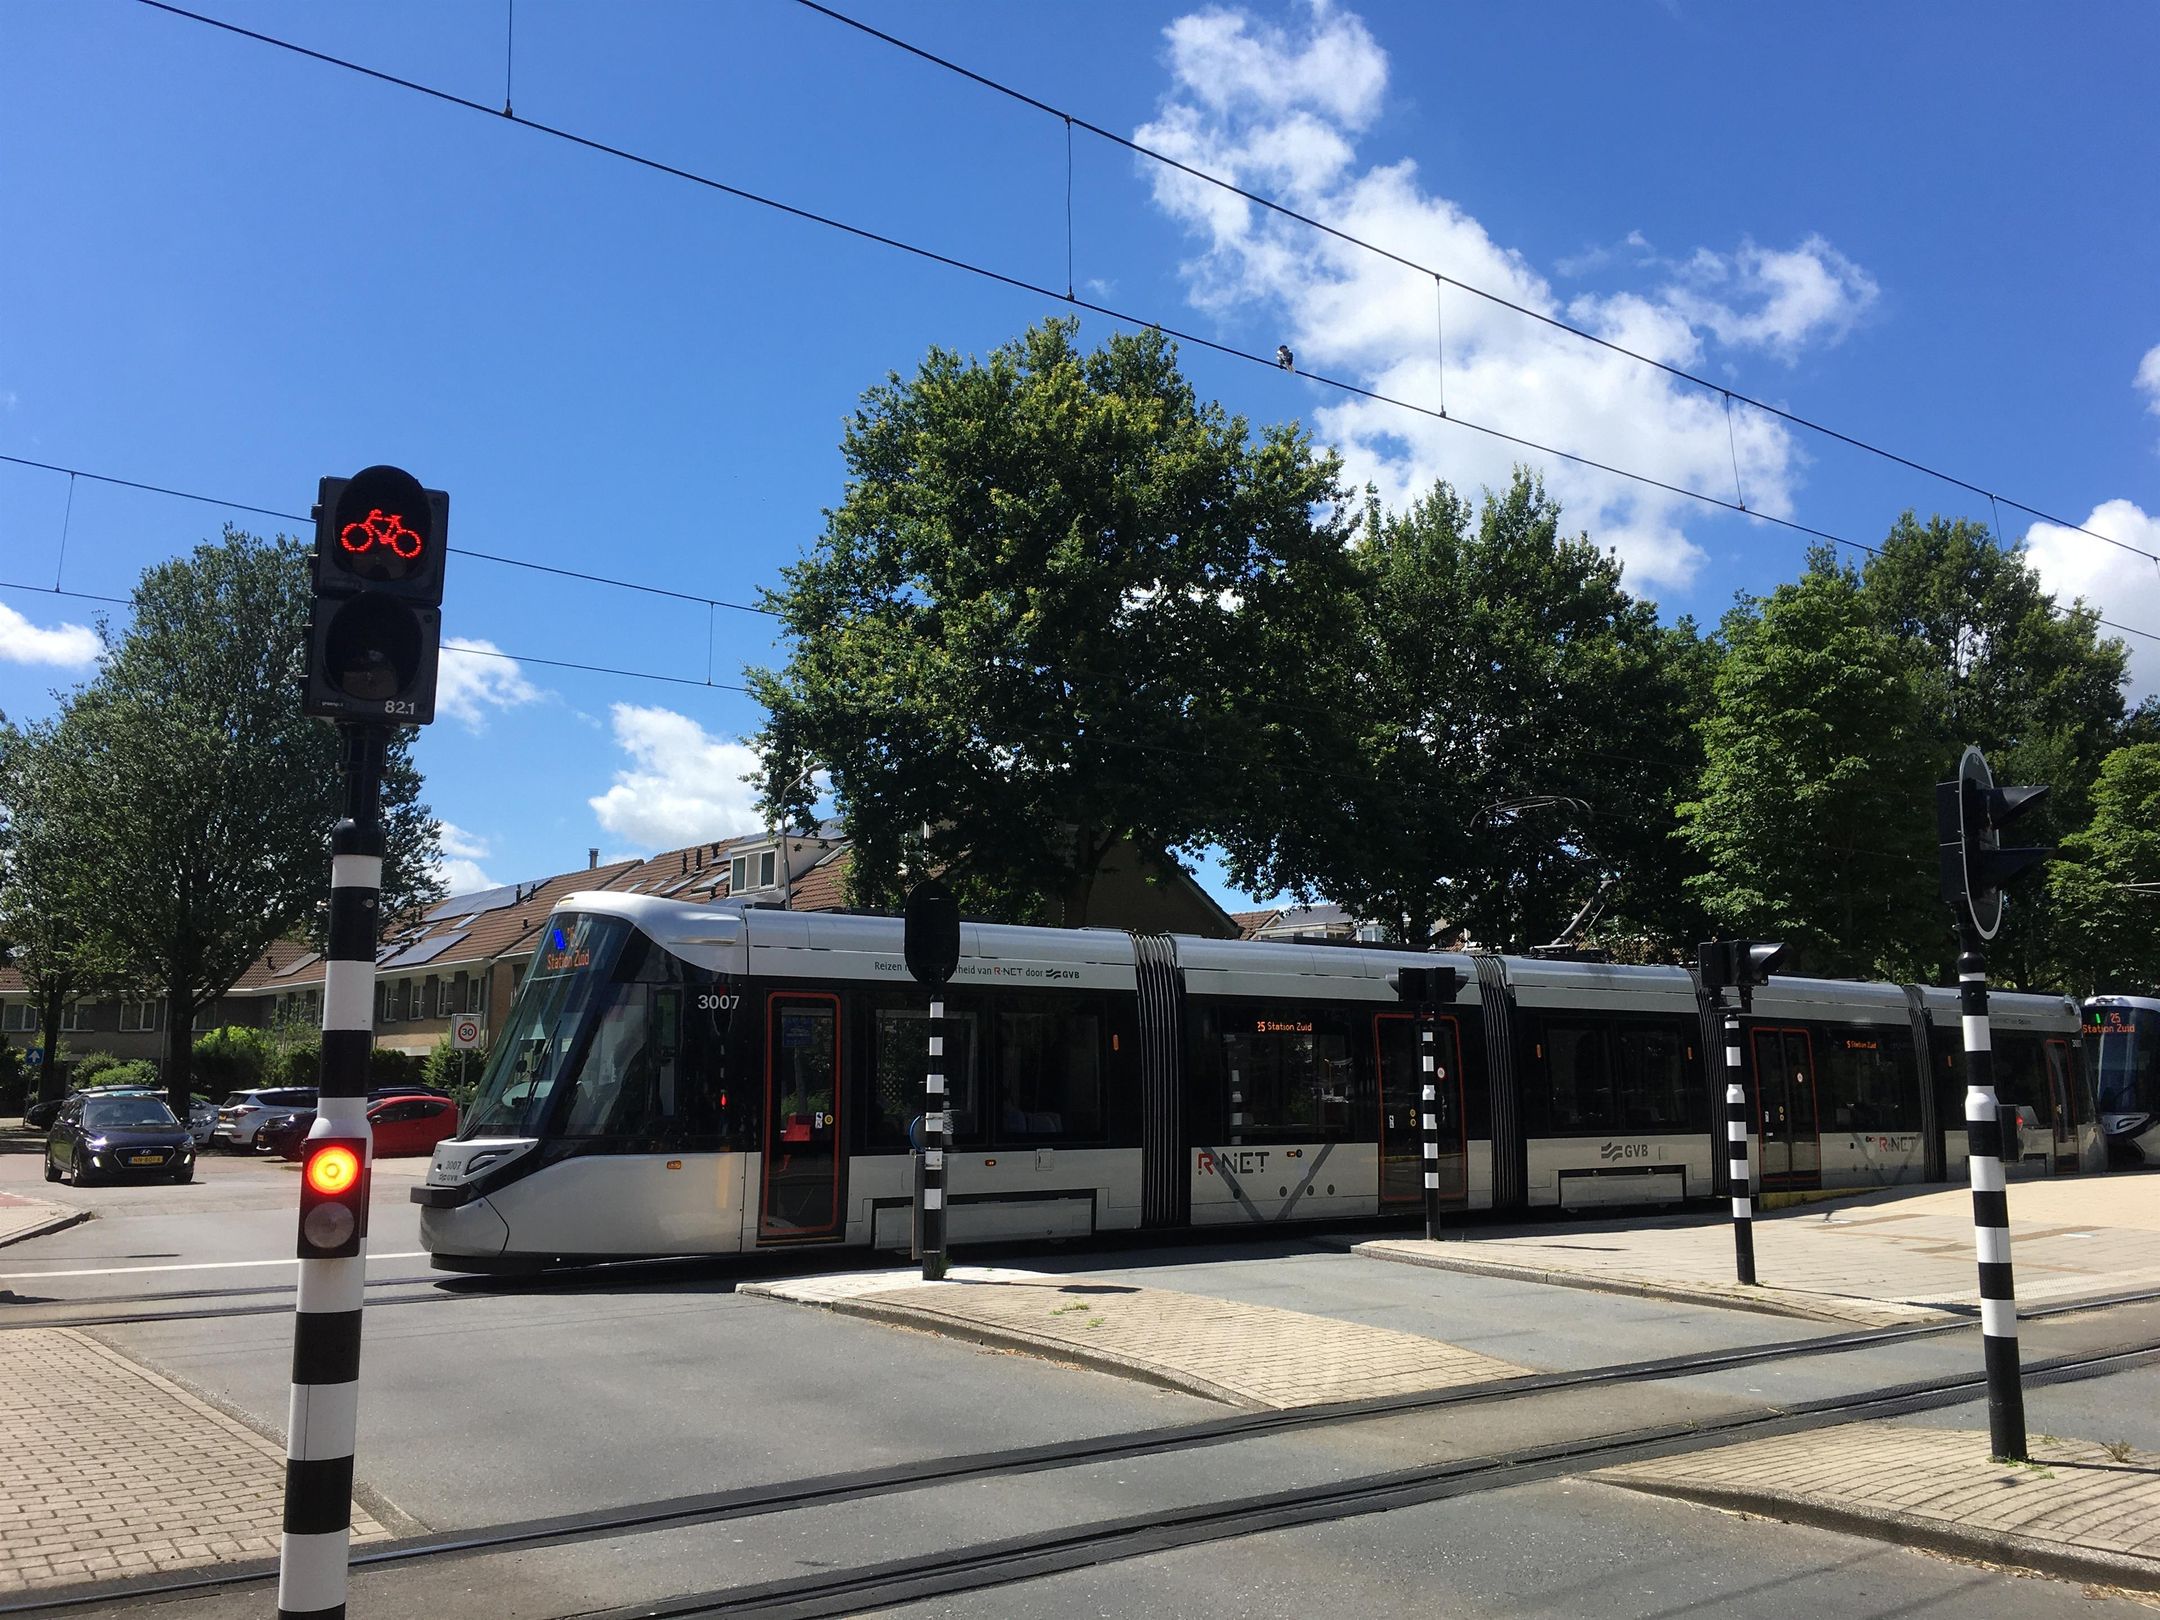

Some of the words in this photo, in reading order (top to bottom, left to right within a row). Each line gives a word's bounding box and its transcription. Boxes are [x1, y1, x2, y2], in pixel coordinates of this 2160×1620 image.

[384, 700, 415, 715] 82.1
[547, 952, 573, 969] Station
[574, 948, 590, 966] Zuid
[874, 961, 902, 971] Reizen
[977, 966, 992, 976] van
[1025, 968, 1043, 978] door
[1062, 971, 1080, 979] GVB
[697, 994, 740, 1010] 3007
[2110, 1012, 2121, 1024] 25
[461, 1028, 474, 1037] 30
[1267, 1021, 1295, 1031] Station
[1296, 1021, 1312, 1031] Zuid
[2082, 1024, 2114, 1033] Station
[2116, 1023, 2135, 1033] Zuid
[1624, 1144, 1649, 1158] GVB
